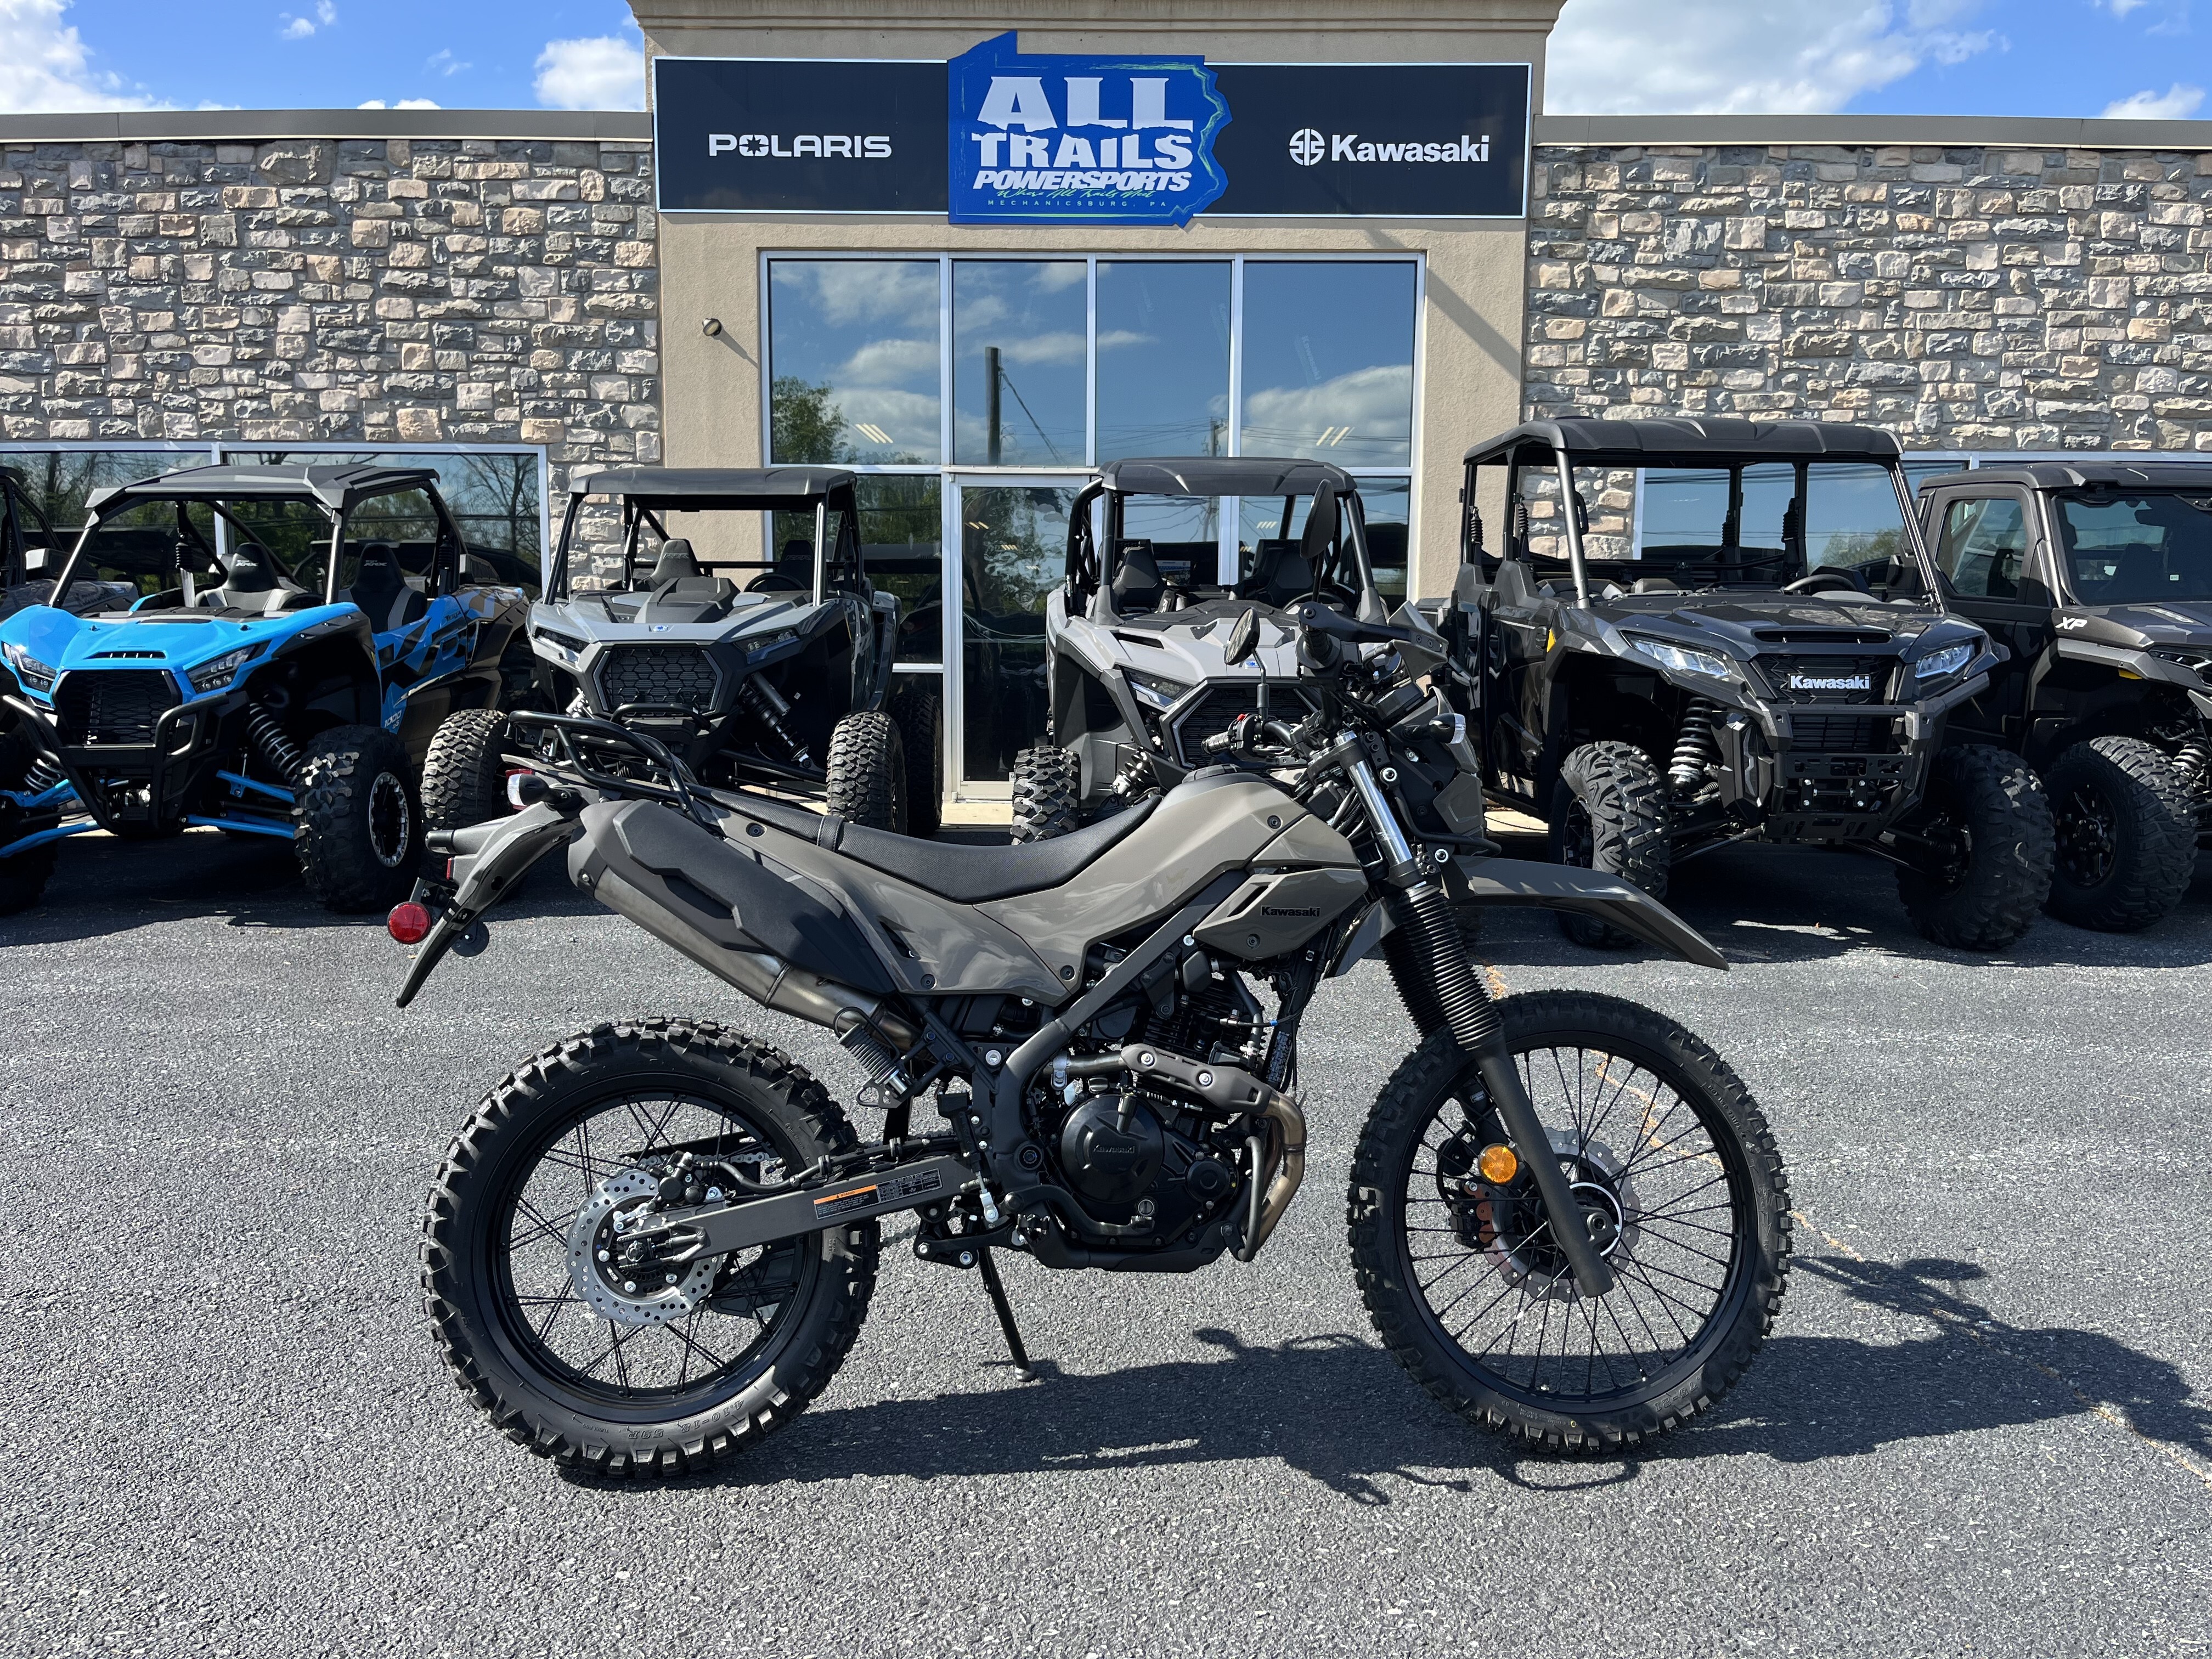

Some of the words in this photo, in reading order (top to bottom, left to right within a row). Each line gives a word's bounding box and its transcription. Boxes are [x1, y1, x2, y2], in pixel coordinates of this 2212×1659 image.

[977, 76, 1193, 132] ALL
[709, 134, 892, 158] POLARIS
[971, 132, 1193, 169] TRAILS
[1331, 135, 1489, 162] Kawasaki
[973, 170, 1192, 191] POWERSPORTS
[997, 188, 1045, 198] Where
[1046, 188, 1074, 198] All
[1079, 188, 1118, 198] Trails
[1119, 189, 1157, 198] Meet
[2055, 617, 2087, 630] XP
[1790, 675, 1870, 689] Kawasaki
[385, 710, 402, 728] 1000
[1261, 906, 1321, 917] Kawasaki
[1093, 1143, 1135, 1153] Kawasaki
[1654, 1376, 1701, 1412] .75-21
[681, 1400, 744, 1433] 4.10-18
